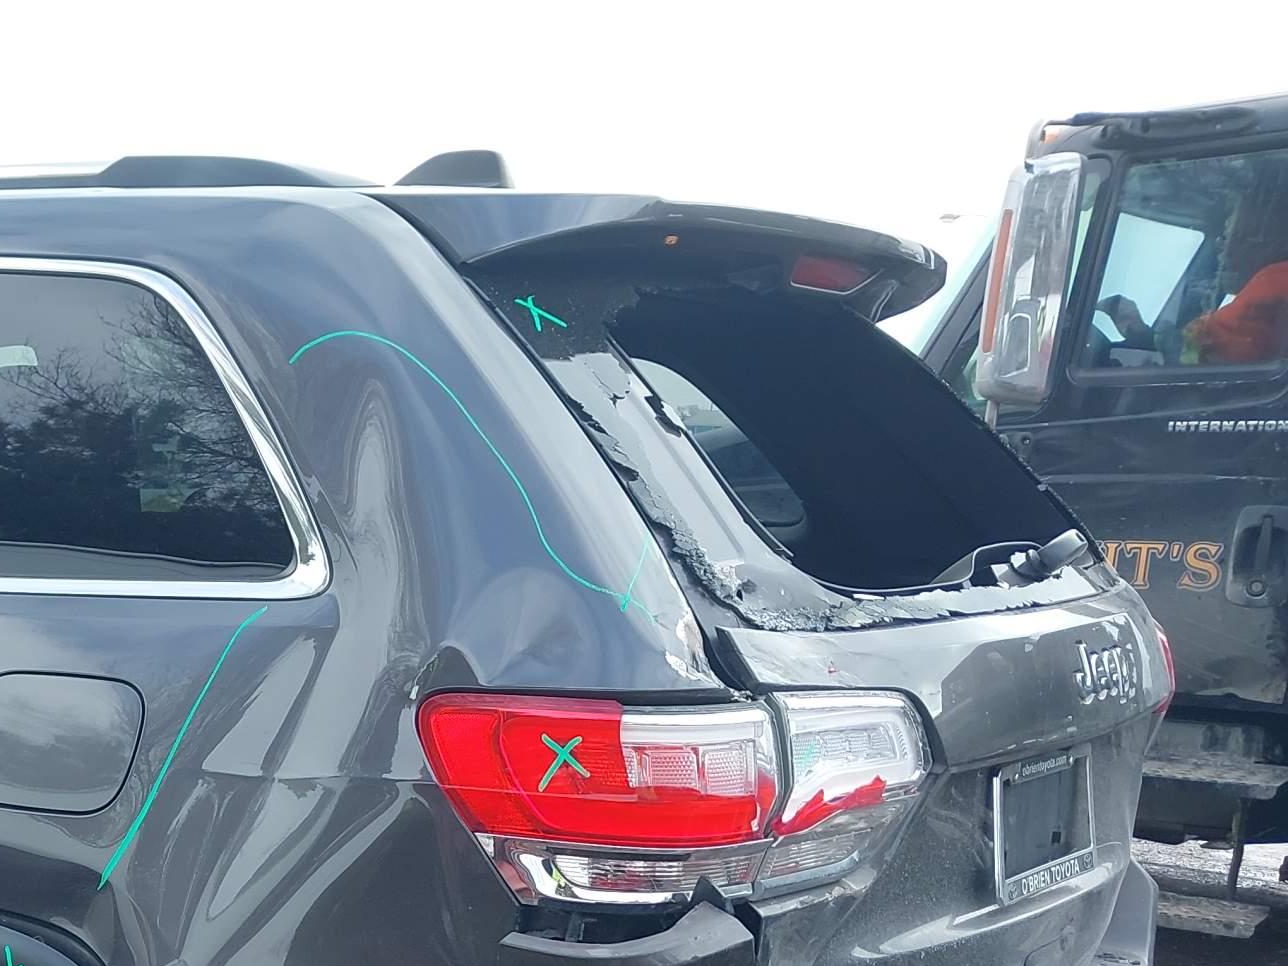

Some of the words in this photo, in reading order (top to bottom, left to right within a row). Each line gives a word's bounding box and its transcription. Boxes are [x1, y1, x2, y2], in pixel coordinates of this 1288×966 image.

[1168, 420, 1288, 433] INTERNATION
[1073, 640, 1136, 704] Jeep
[1021, 872, 1051, 895] O'BRIEN
[1051, 858, 1080, 883] TOYOTA
